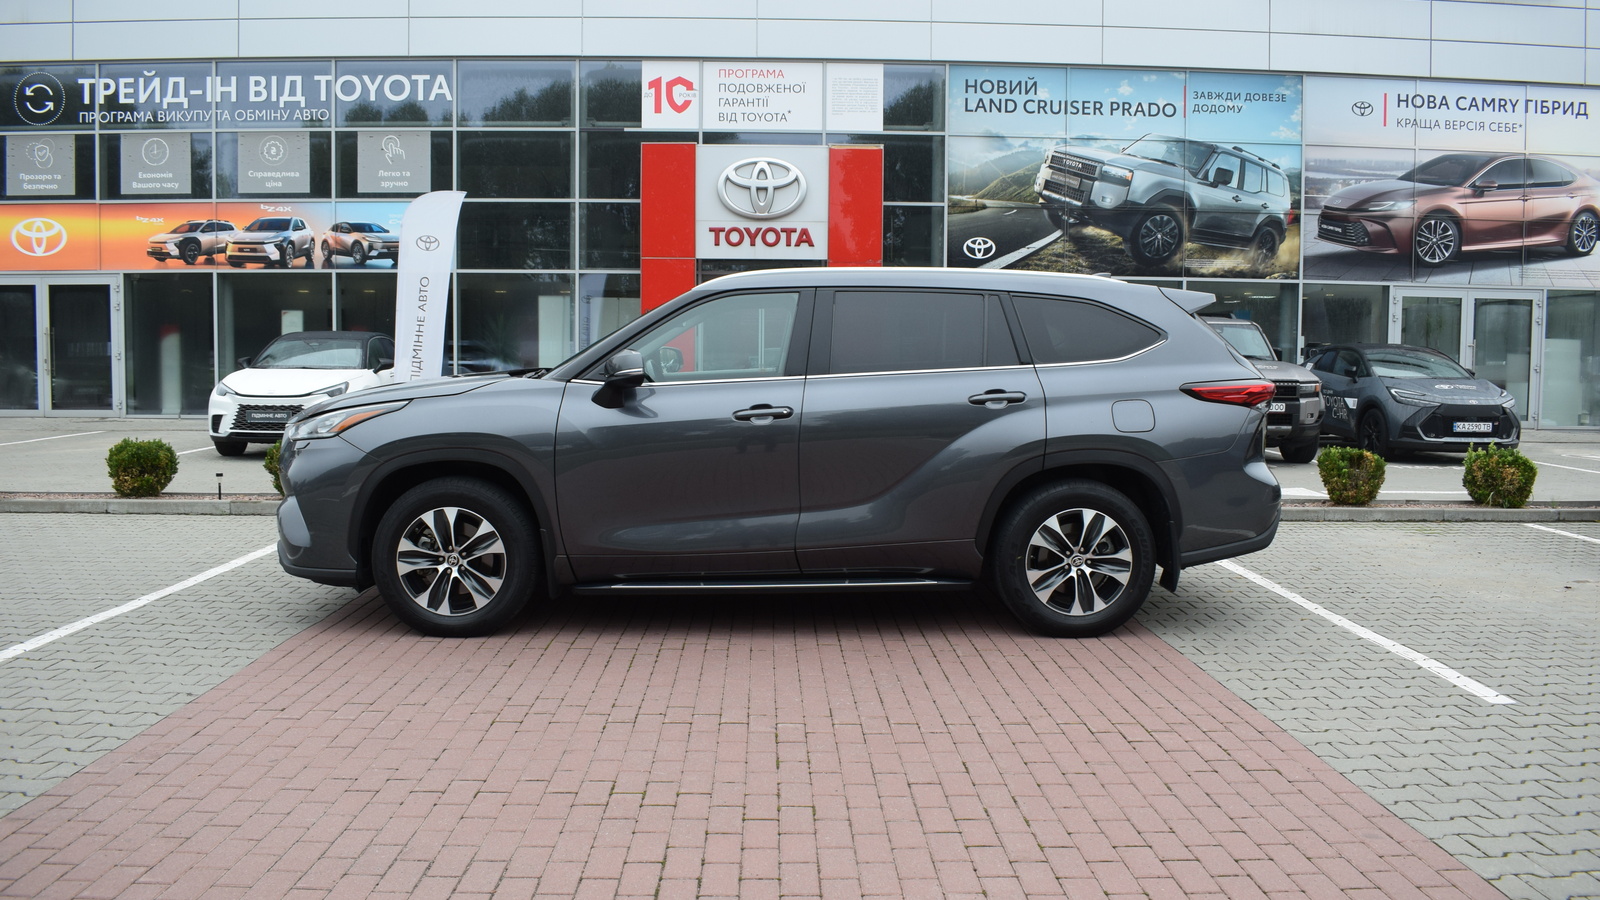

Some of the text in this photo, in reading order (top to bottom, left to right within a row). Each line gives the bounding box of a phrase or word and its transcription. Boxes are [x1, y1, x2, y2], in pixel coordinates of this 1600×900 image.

[718, 69, 785, 79] ПРОГРАМА
[78, 70, 453, 109] ТРЕЙД-ІН ВІД TOYOTA
[718, 82, 807, 95] ПОДОВЖЕНОЇ
[964, 76, 1038, 95] НОВИЙ
[648, 76, 694, 114] 10
[1192, 91, 1287, 103] ЗАВЖДИ ДОВЕЗЕ
[718, 96, 769, 108] ГАРАНТІЇ
[964, 97, 1177, 118] LAND CRUISER PRADO
[1397, 93, 1589, 120] НОВА CAMRY ГІБРИД
[1192, 103, 1243, 114] ДОДОМУ
[79, 109, 330, 123] ПРОГРАМА ВИКУПУ ТА ОБМІНУ АВТО
[718, 112, 737, 123] ВІД
[1396, 117, 1441, 131] КРАЩА
[1444, 119, 1485, 131] ВЕРСІЯ
[1063, 159, 1082, 168] TOYOTA
[19, 173, 52, 181] Прозоро
[248, 170, 300, 179] Справедлива
[132, 181, 179, 190] Вашого часу
[265, 180, 282, 188] ціна
[709, 226, 815, 247] TOYOTA
[418, 276, 430, 312] АВТО
[1332, 407, 1349, 419] C-HR
[1456, 423, 1468, 431] KA
[1467, 423, 1482, 431] 2590
